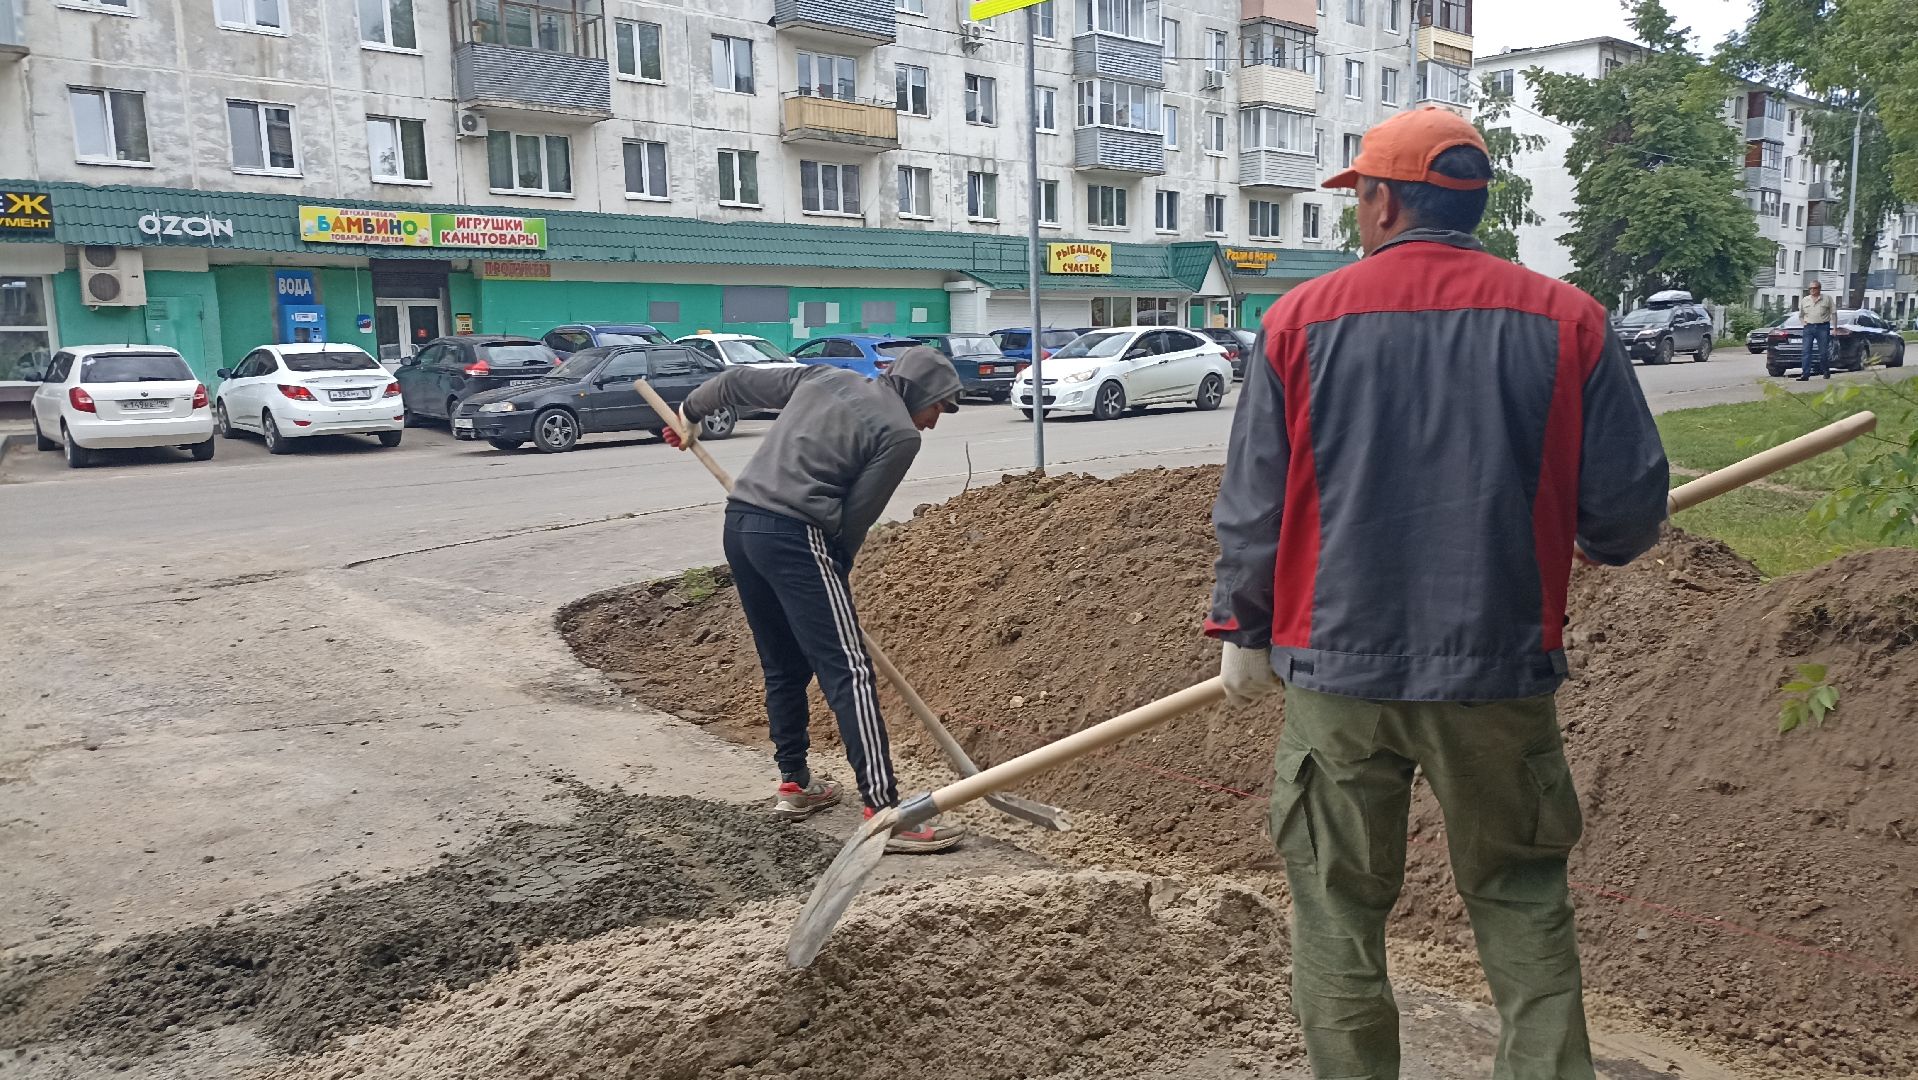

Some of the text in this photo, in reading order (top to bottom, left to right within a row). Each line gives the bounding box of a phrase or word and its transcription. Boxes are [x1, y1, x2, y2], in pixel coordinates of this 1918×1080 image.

[0, 194, 49, 214] Ж
[138, 212, 234, 238] OZON
[317, 215, 418, 236] БАМБИНО
[456, 217, 523, 231] ИГРУШКИ
[331, 233, 362, 242] ТОВАРЫ
[441, 232, 538, 246] КАНЦТОВАРЫ
[1056, 244, 1108, 262] РЫБАЦКОЕ
[1062, 263, 1100, 273] СЧАСТЬЕ
[278, 277, 312, 297] ВОДА
